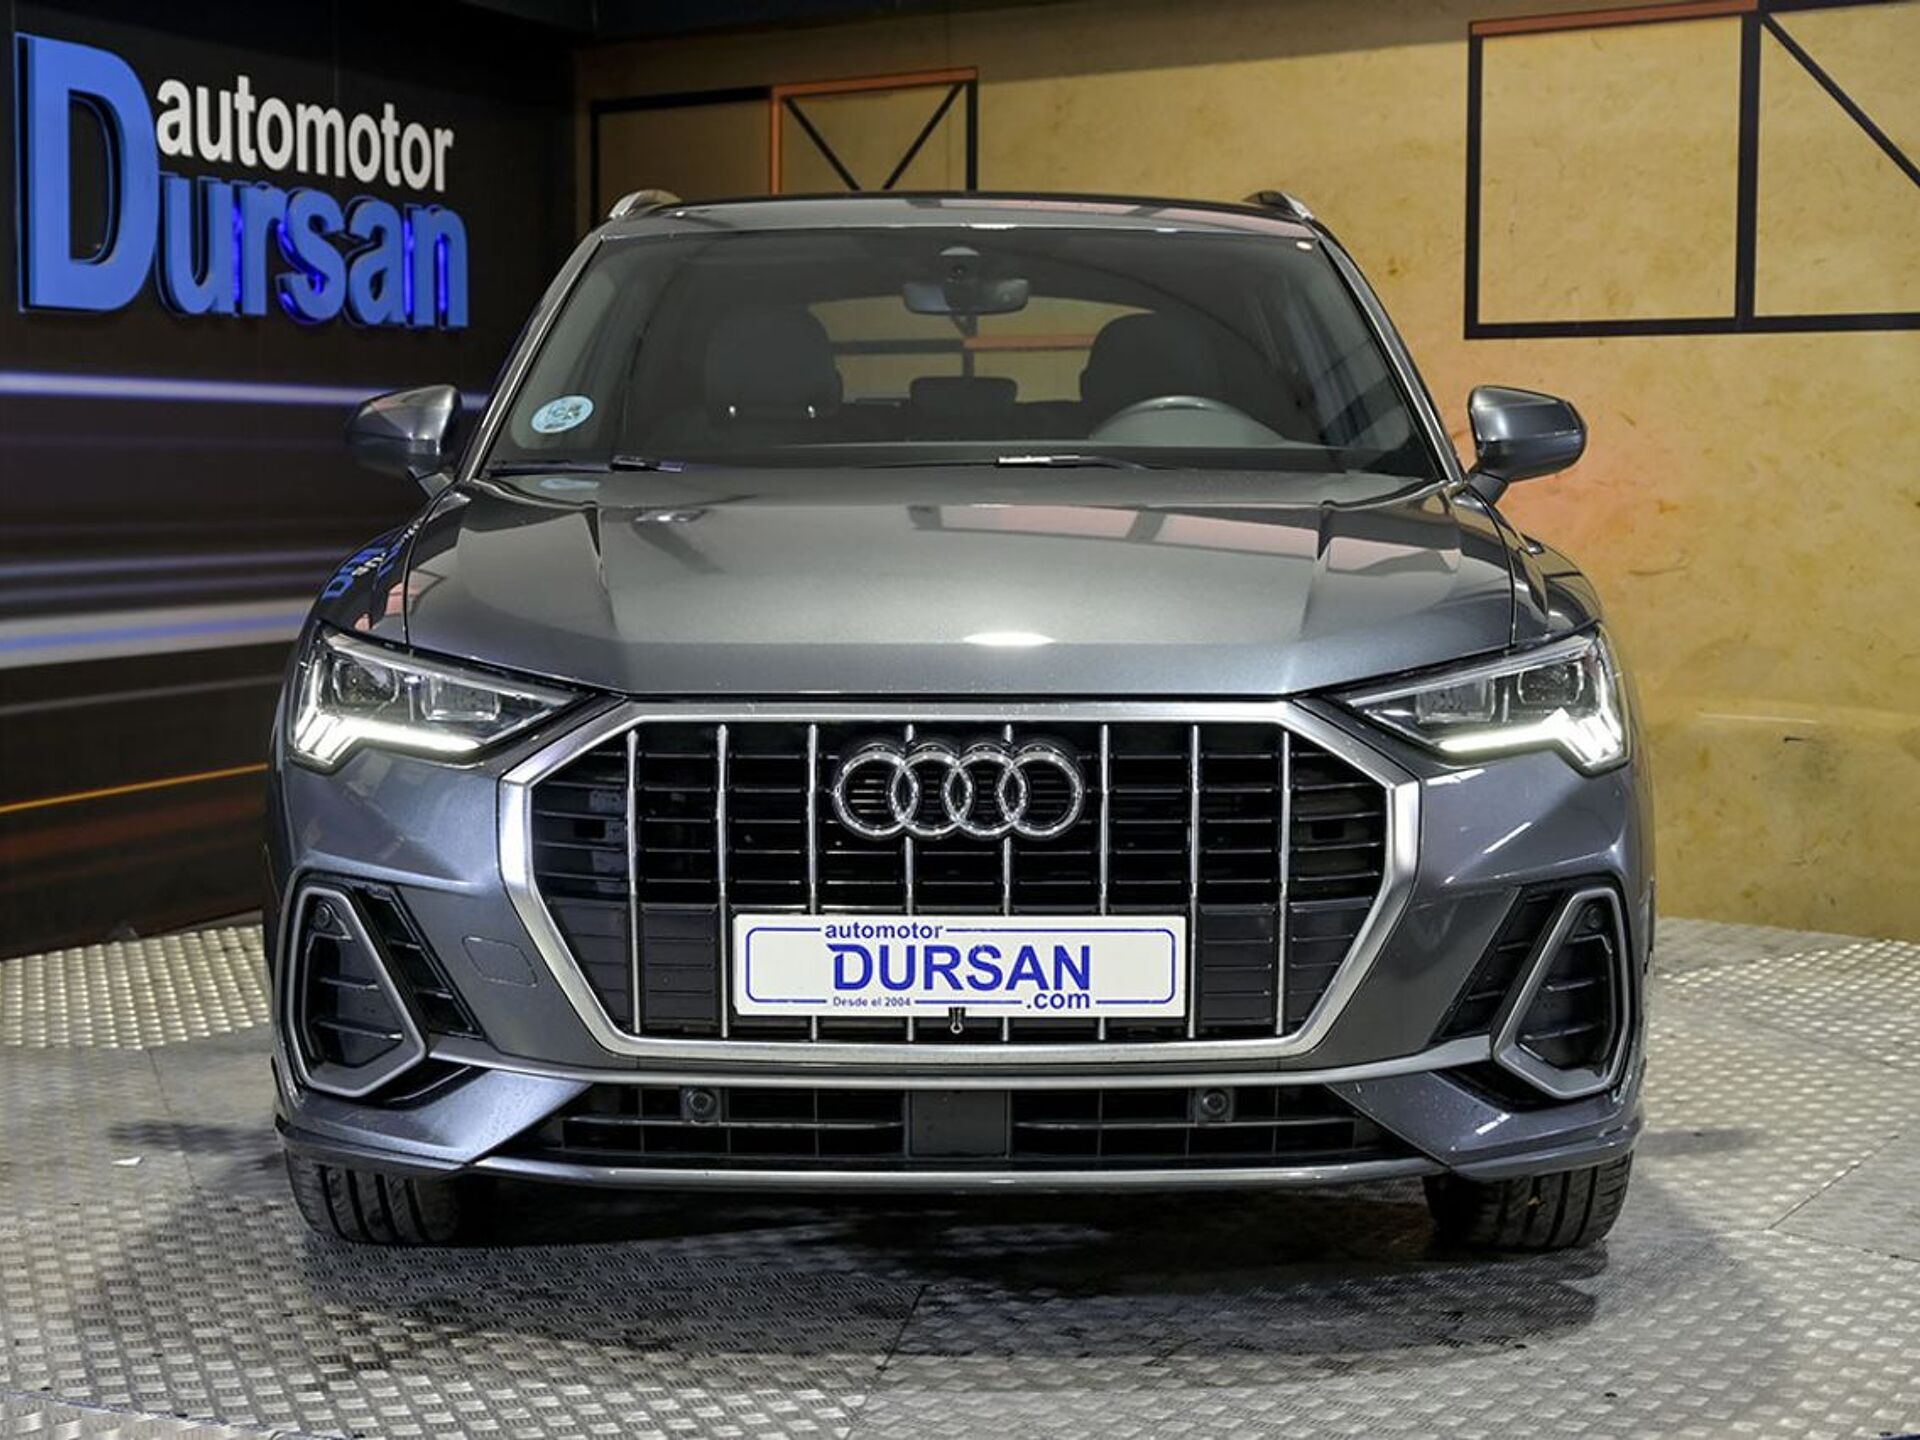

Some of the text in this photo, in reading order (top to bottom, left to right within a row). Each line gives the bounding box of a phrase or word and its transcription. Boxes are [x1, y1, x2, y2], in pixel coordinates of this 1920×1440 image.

[156, 75, 454, 193] automotor
[14, 32, 469, 331] Dursan
[825, 922, 943, 939] automotor
[826, 944, 1090, 991] DURSAN
[833, 996, 911, 1007] Desde el 2004
[1026, 993, 1090, 1010] .com
